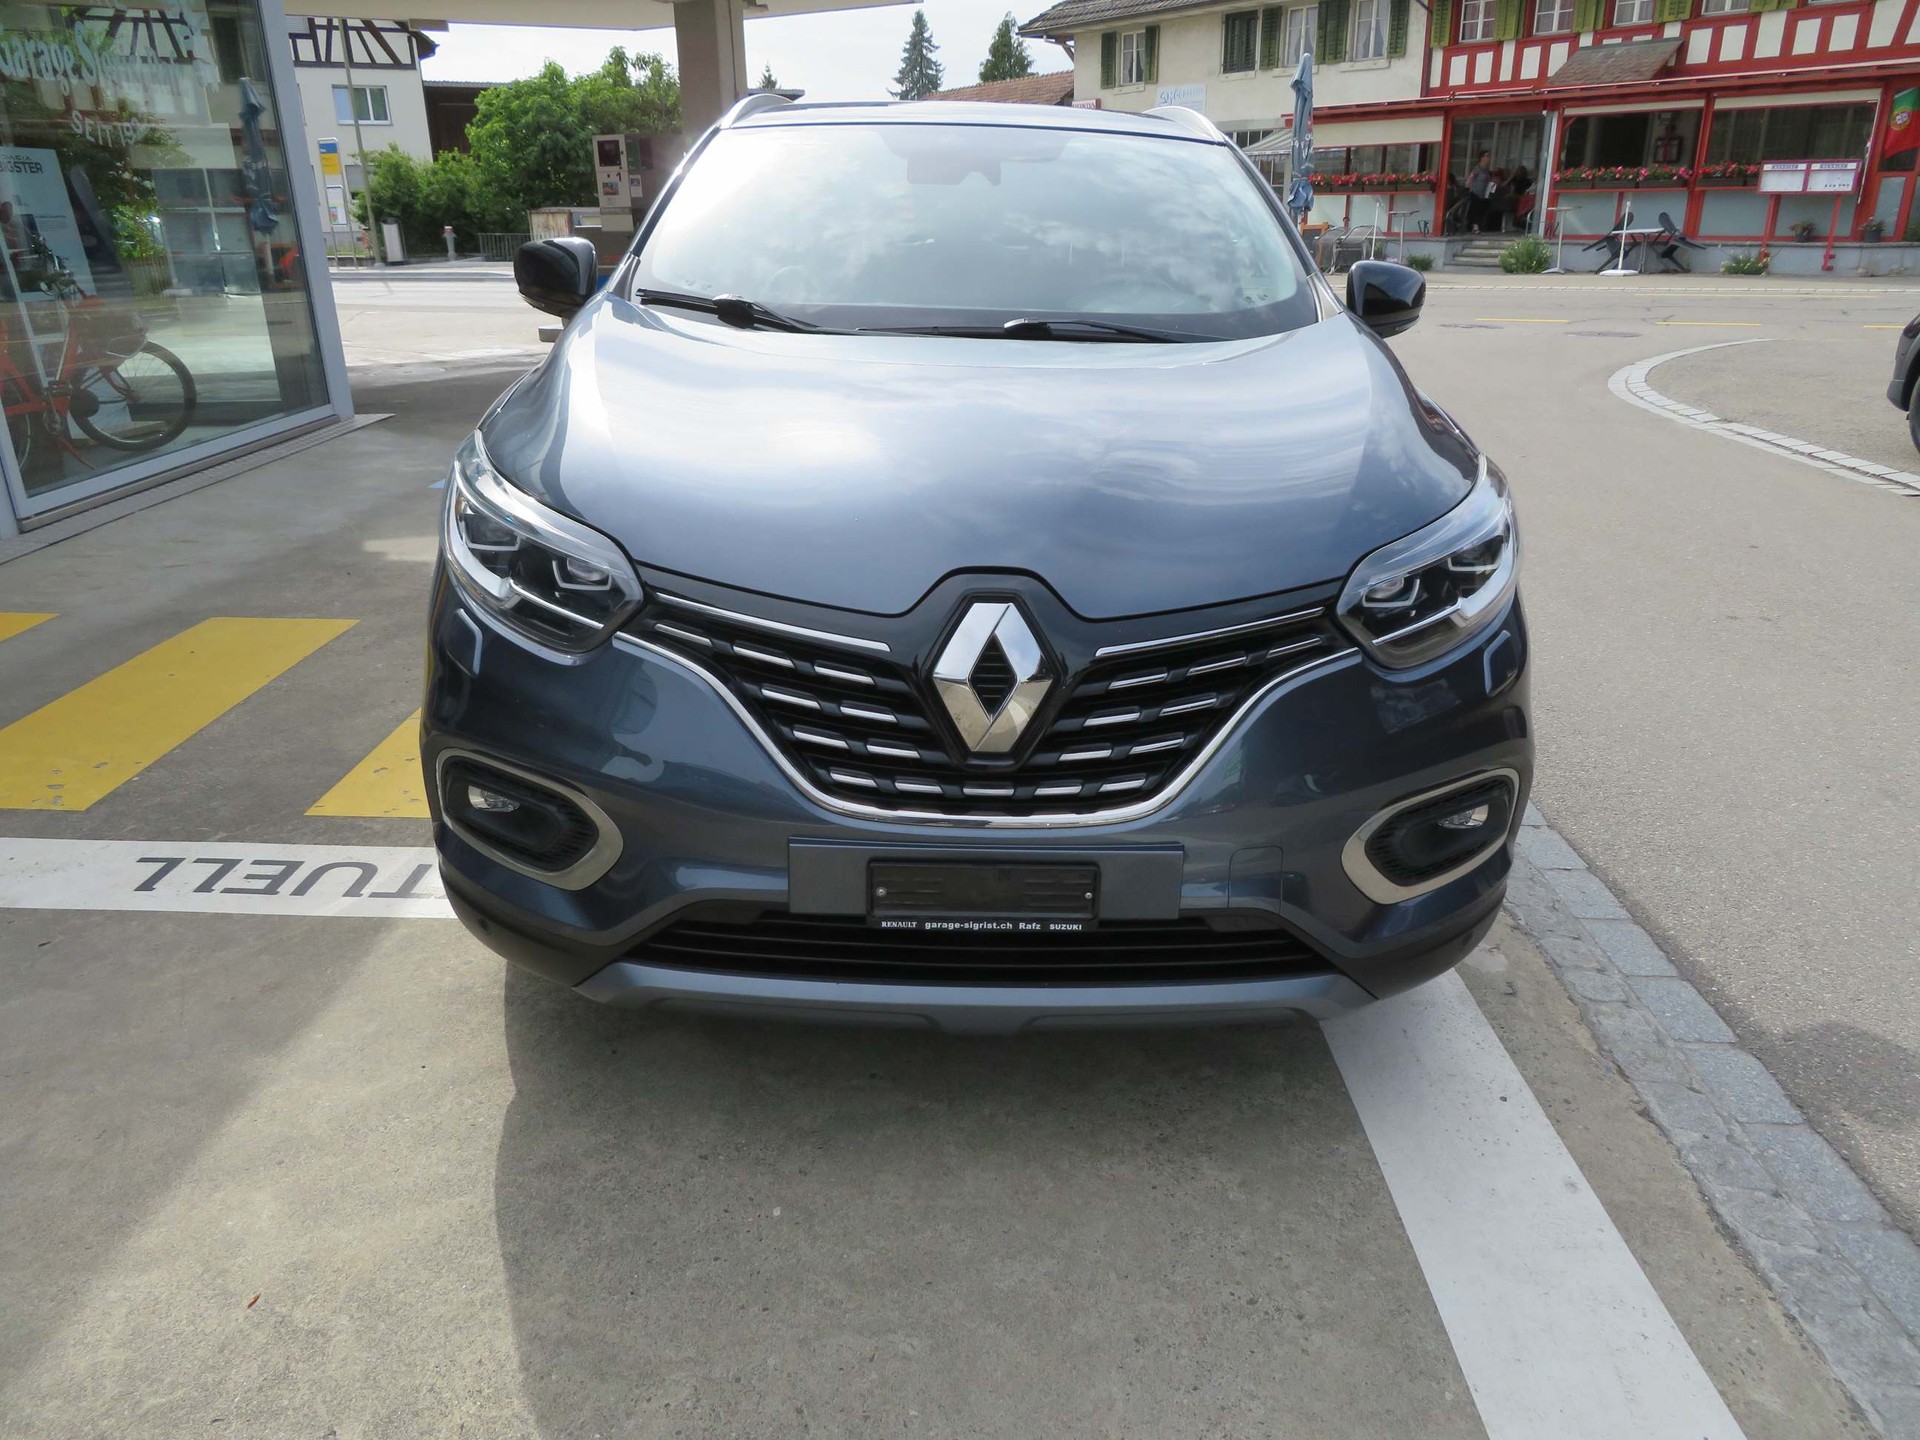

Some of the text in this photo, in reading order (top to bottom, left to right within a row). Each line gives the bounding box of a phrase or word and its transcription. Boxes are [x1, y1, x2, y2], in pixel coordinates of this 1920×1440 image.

[71, 110, 113, 148] SEIT
[925, 921, 1013, 930] garage-sigrist.ch
[1019, 922, 1041, 930] Rafz
[1050, 923, 1082, 931] SUZUKI
